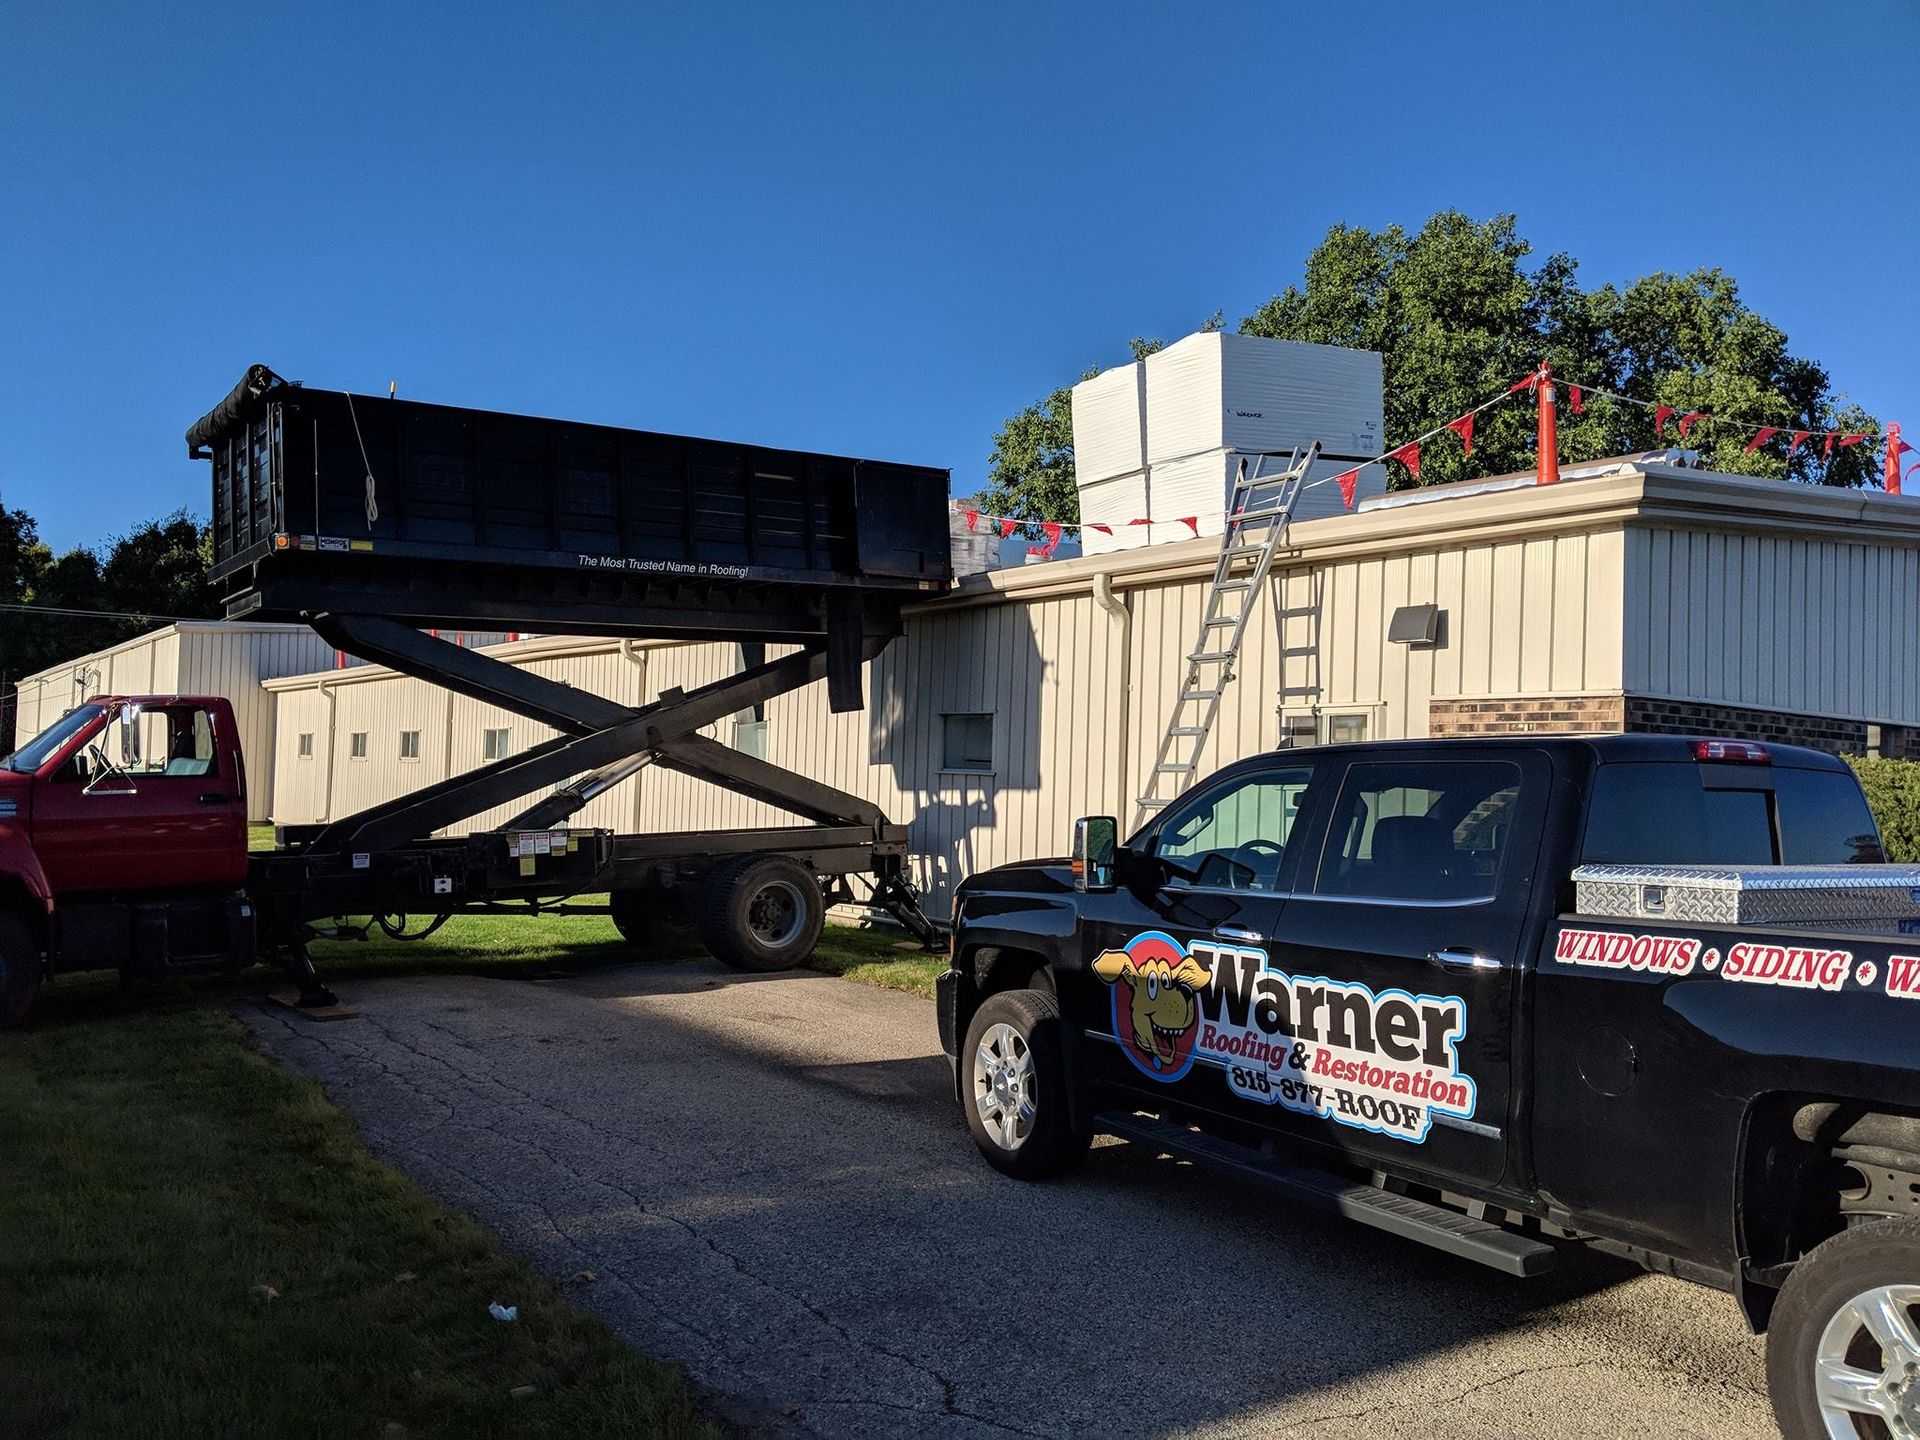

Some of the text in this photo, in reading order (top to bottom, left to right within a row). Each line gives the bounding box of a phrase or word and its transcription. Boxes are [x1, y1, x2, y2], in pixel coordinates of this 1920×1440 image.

[578, 555, 749, 579] The Most Trusted Name in Roofing!
[1556, 930, 1697, 971] WINDOWS
[1724, 945, 1848, 985] SIDING
[1193, 949, 1458, 1068] Warner
[1201, 1024, 1468, 1108] Roofing & Restoration
[1231, 1066, 1422, 1131] 815-877-ROOF
